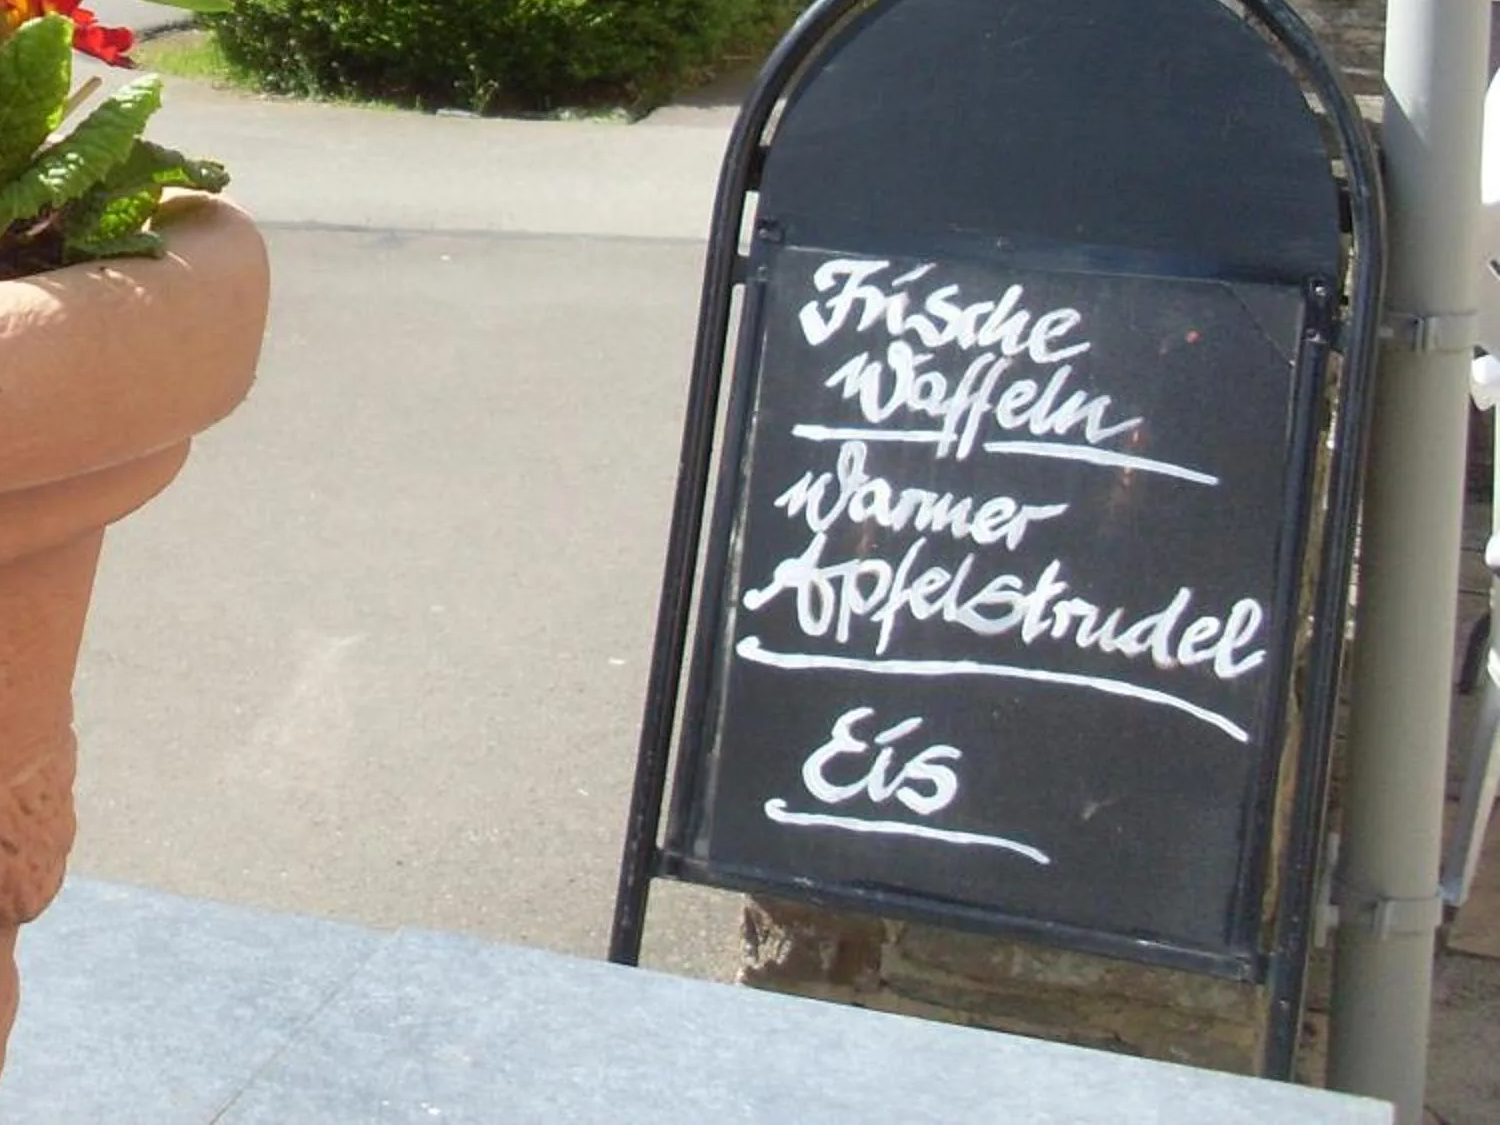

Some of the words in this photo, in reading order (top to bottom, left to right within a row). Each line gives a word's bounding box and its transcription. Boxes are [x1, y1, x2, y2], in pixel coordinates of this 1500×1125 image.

[799, 259, 1091, 363] Frische
[825, 341, 1144, 459] Waffeln
[744, 534, 1267, 679] Apfelstrudel
[802, 706, 962, 815] Eis
